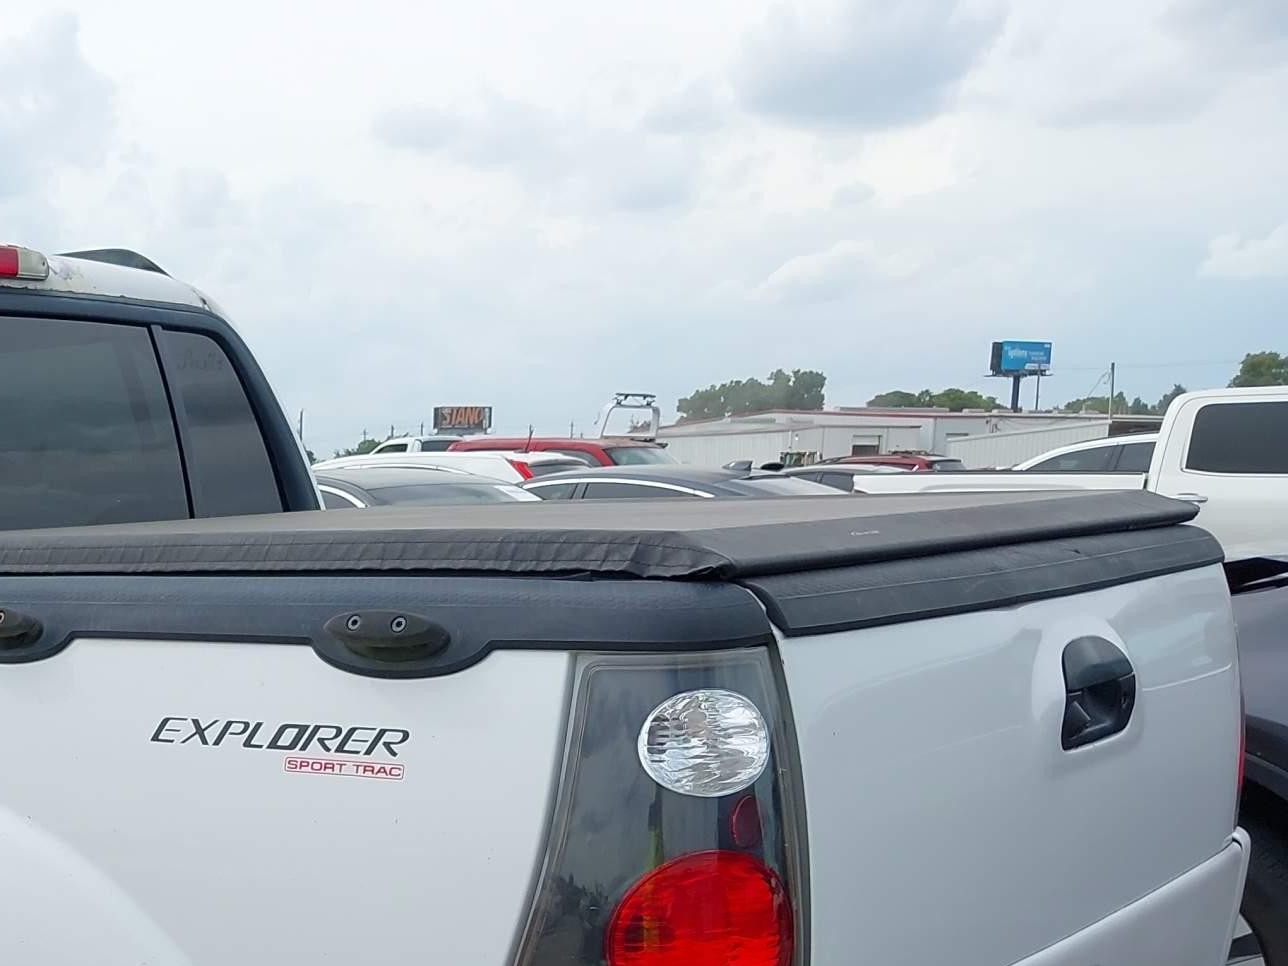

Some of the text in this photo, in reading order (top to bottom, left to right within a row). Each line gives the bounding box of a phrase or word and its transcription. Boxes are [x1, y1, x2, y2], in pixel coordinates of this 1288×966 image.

[149, 716, 410, 758] EXPLORER
[286, 759, 403, 778] SPORT TRAC
